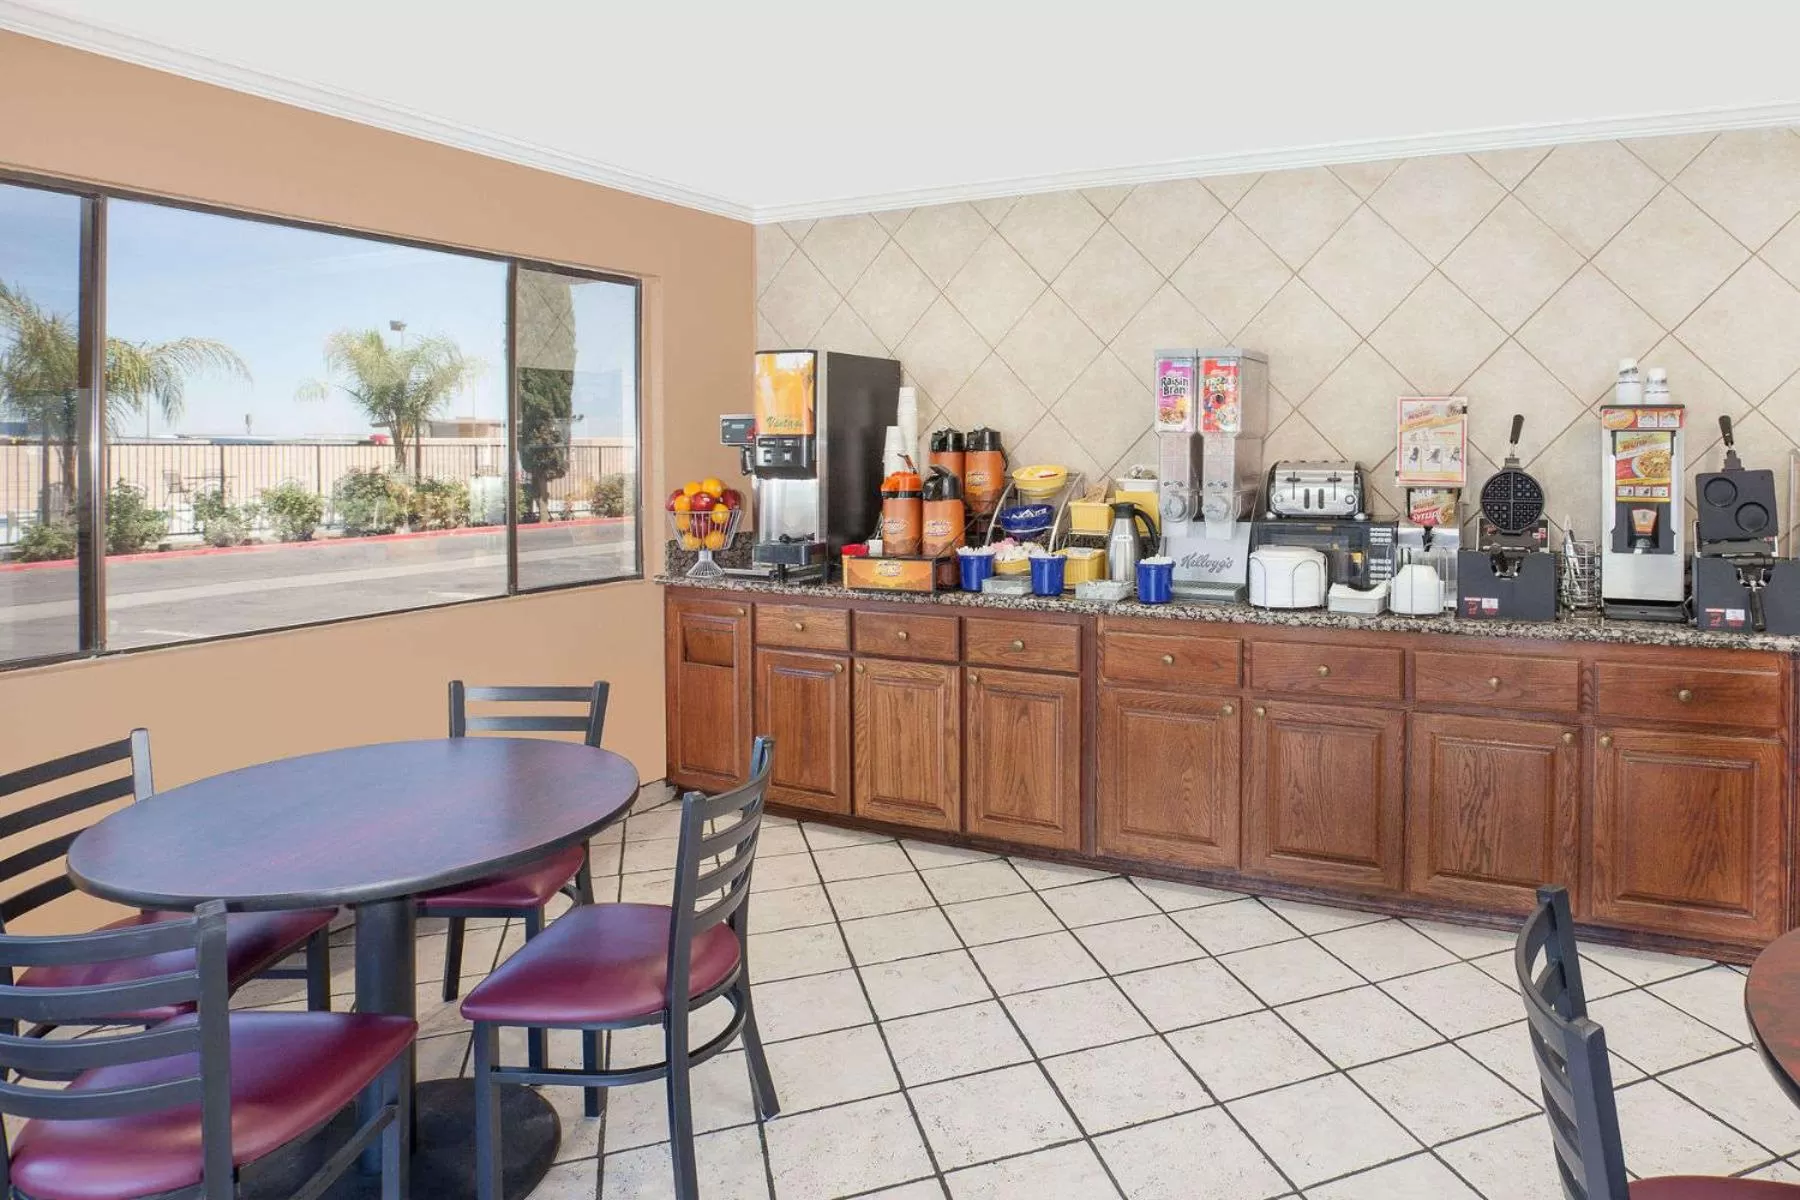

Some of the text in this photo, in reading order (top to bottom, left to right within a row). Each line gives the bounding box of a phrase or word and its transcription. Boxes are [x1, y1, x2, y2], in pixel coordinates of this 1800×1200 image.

[1161, 376, 1189, 387] Raisin
[1163, 385, 1187, 396] Bran
[1180, 551, 1234, 573] Kellogg's
